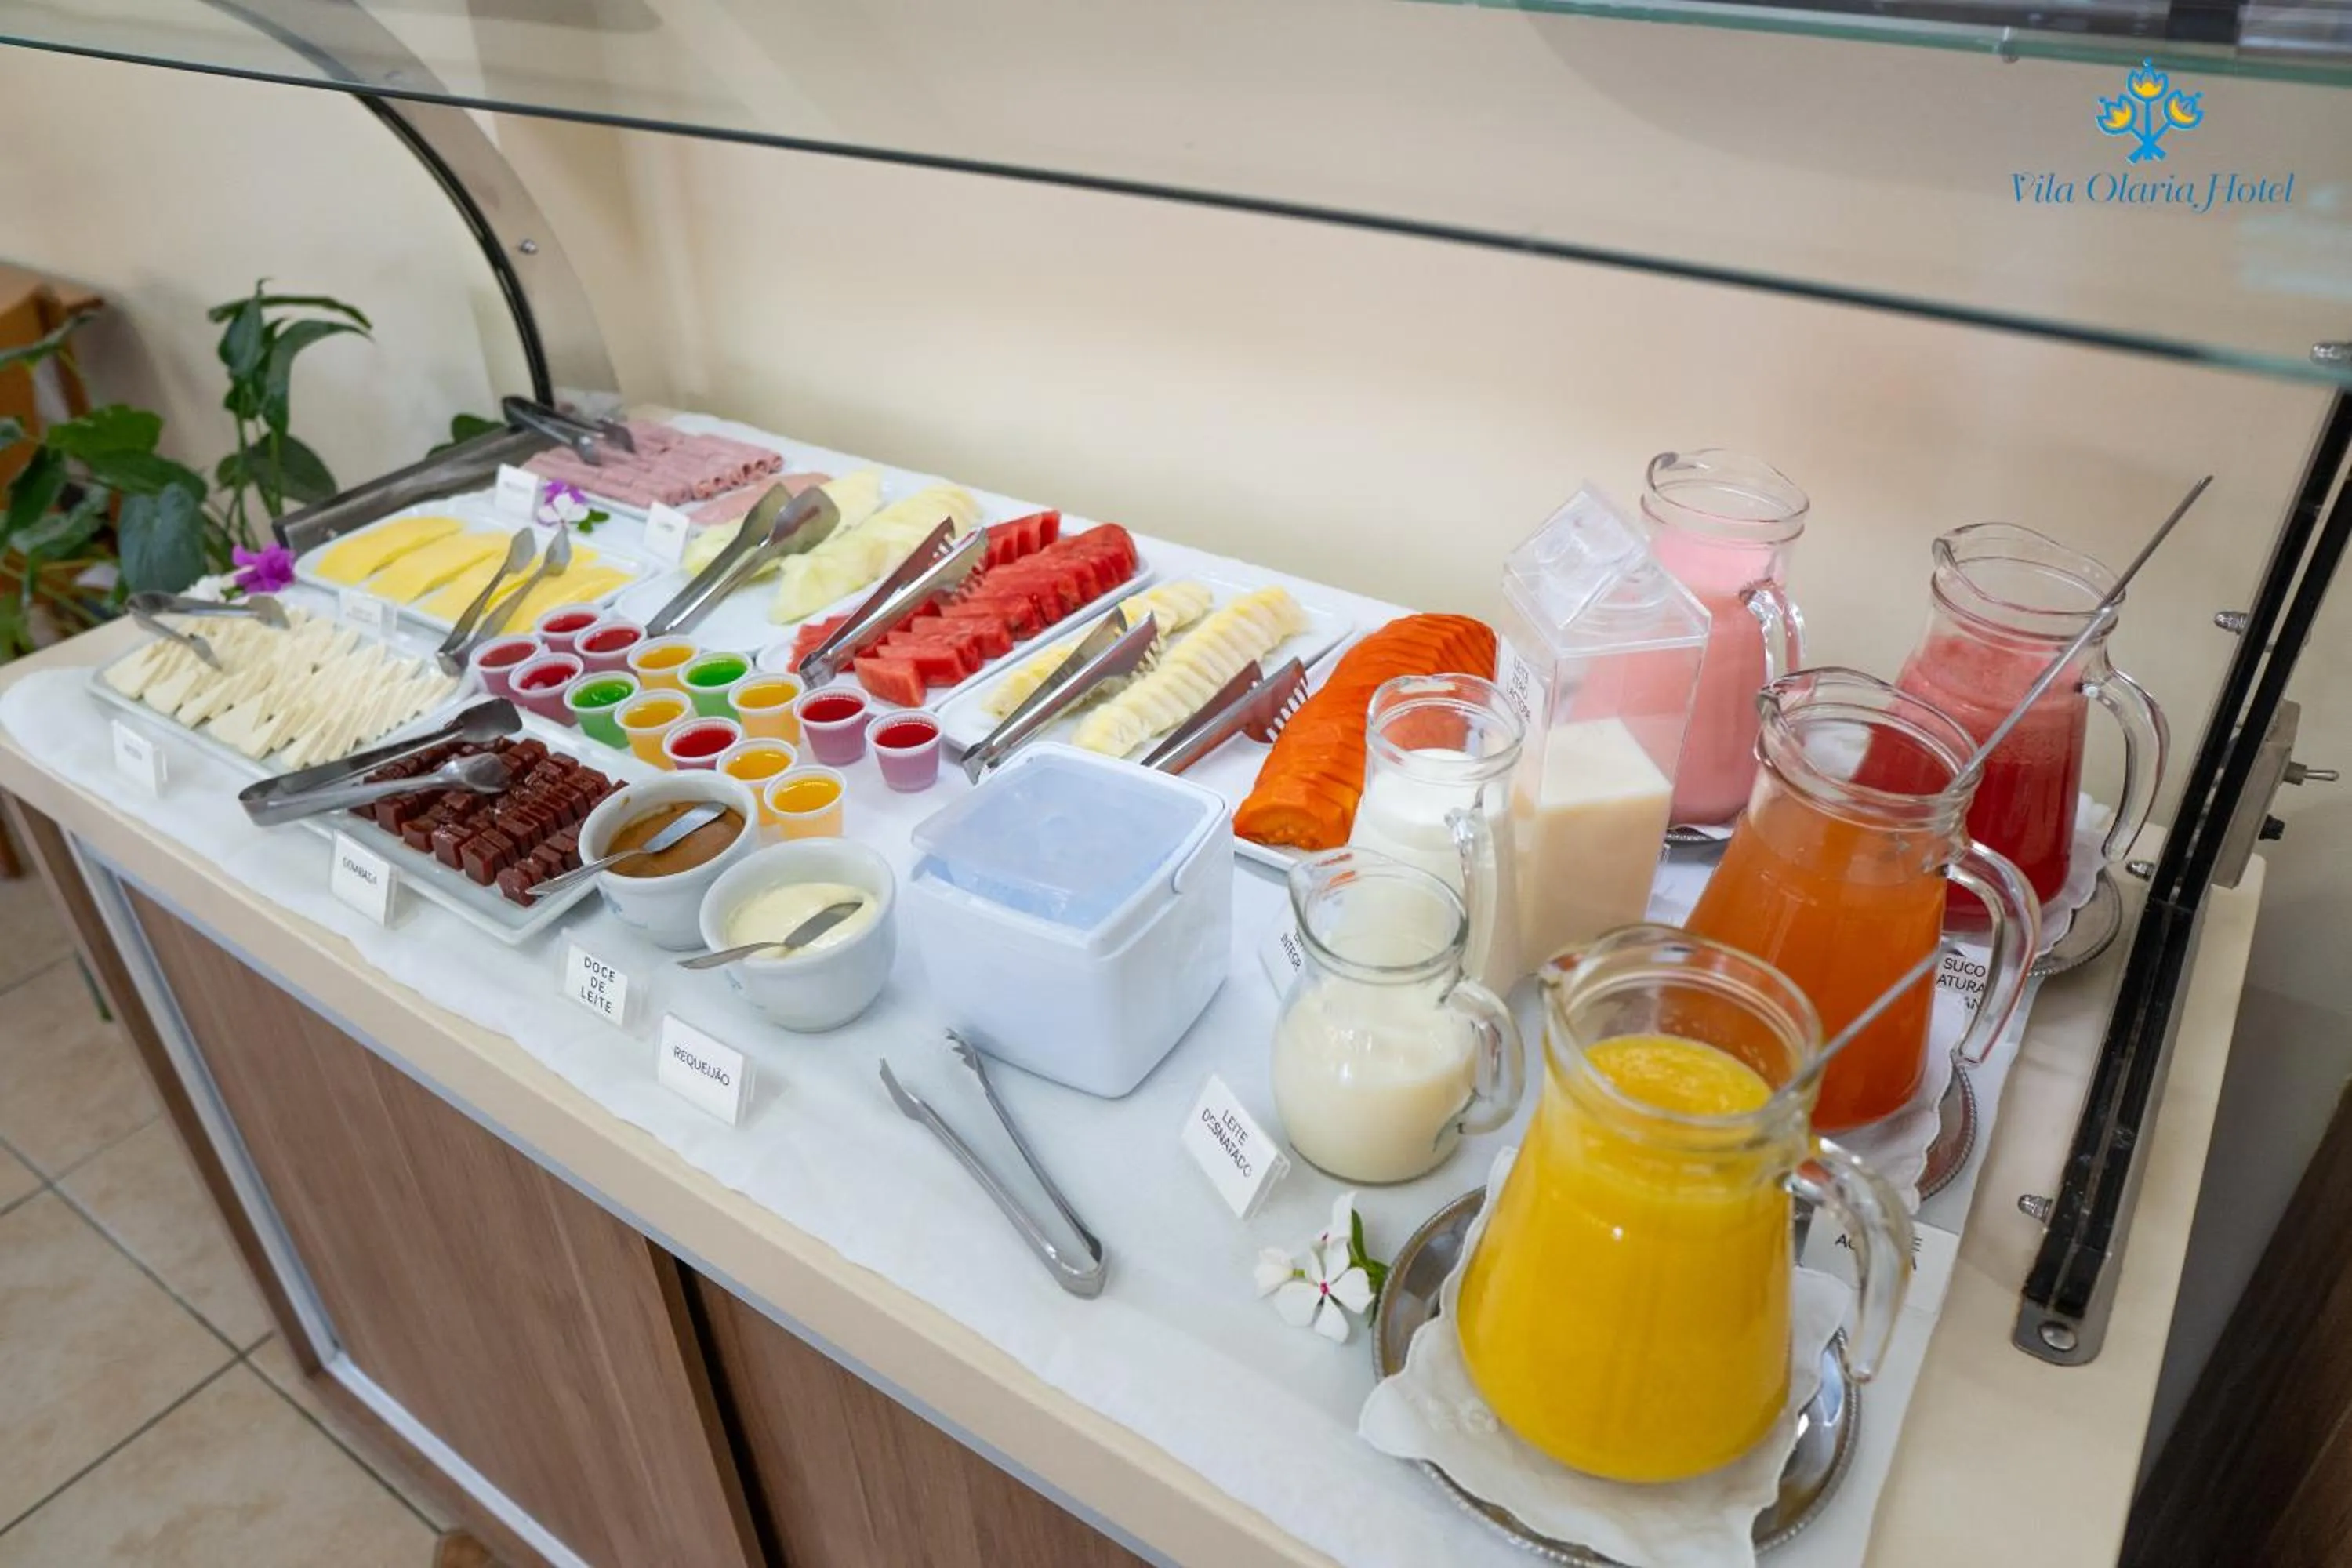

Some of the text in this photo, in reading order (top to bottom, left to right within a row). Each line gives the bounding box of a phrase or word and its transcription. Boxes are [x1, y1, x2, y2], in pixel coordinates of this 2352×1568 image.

[584, 956, 615, 982] DOCE
[1943, 957, 1986, 978] SUCO
[590, 976, 606, 993] DE
[1936, 974, 1984, 993] ATURA
[581, 986, 612, 1014] LEITE
[673, 1045, 730, 1086] REQUEIJÃO
[1222, 1109, 1248, 1146] LEITE
